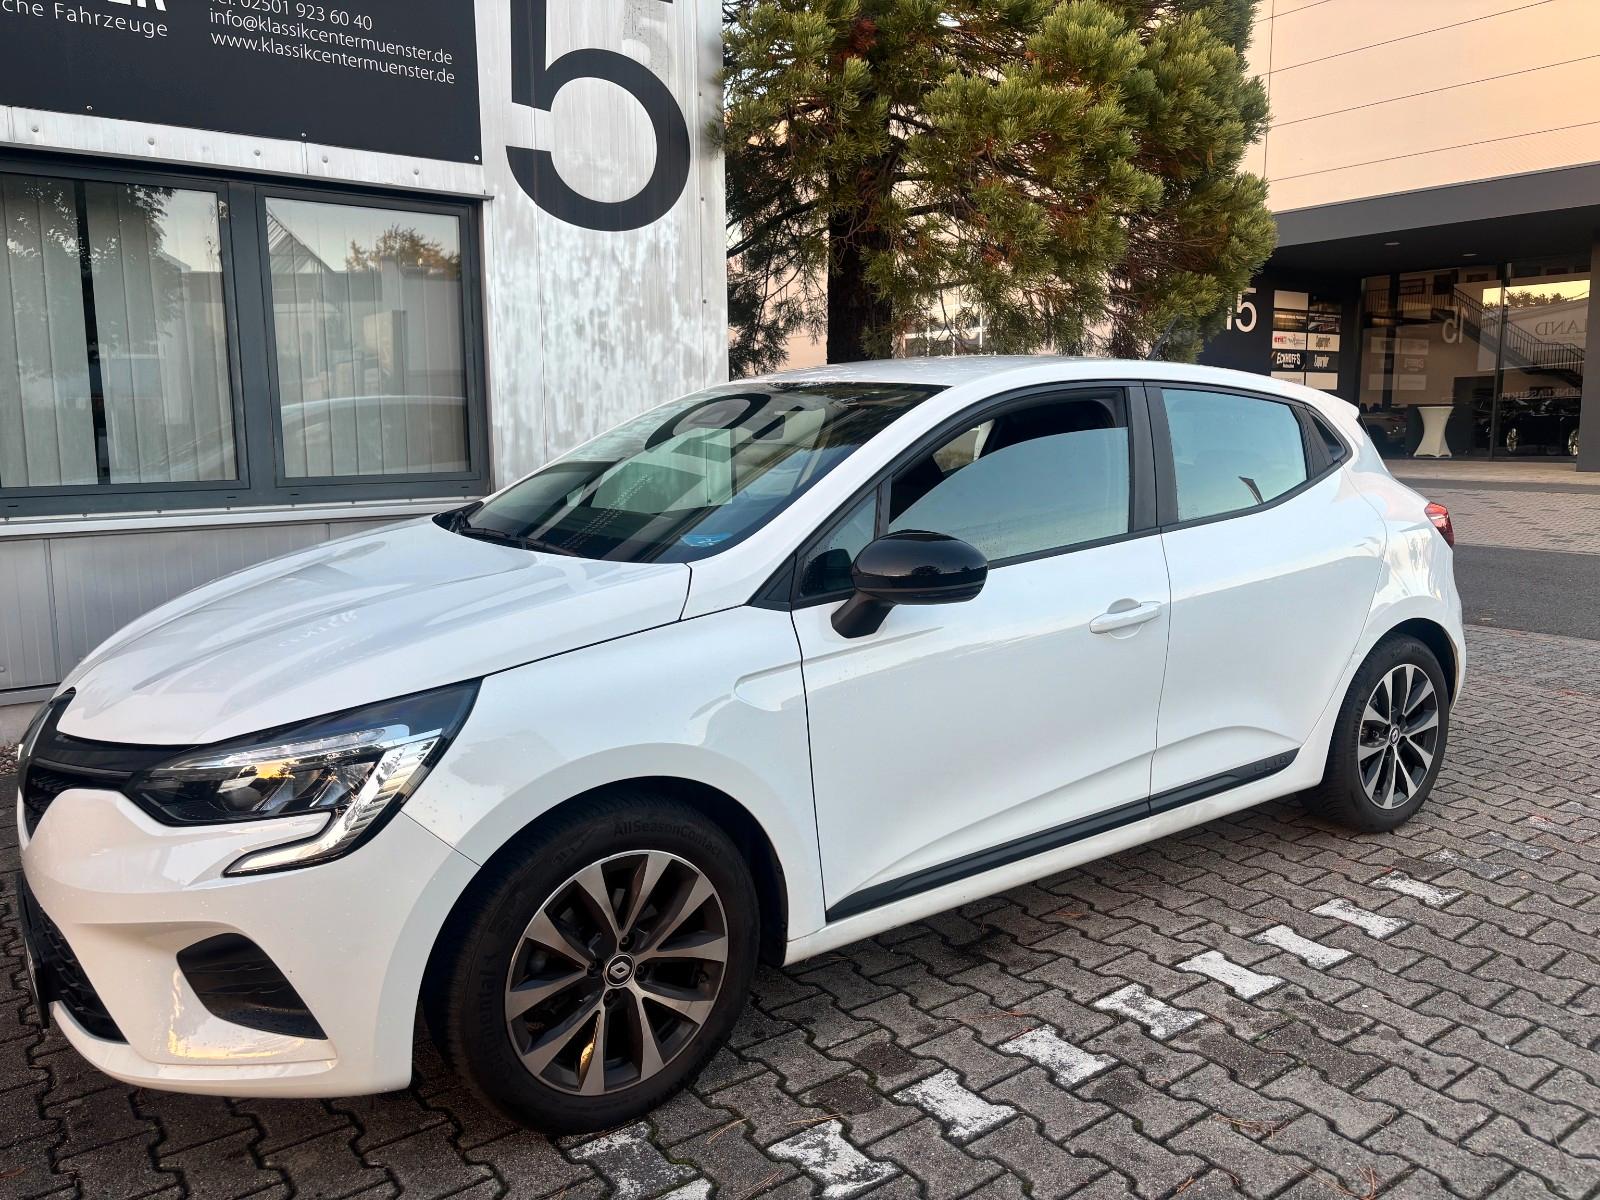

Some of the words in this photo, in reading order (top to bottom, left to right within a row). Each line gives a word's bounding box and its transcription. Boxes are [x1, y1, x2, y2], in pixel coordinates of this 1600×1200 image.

[54, 2, 168, 39] Fahrzeuge
[209, 7, 453, 65] info@klassikcentermuenster.de
[296, 3, 325, 22] 923
[330, 9, 349, 26] 60
[353, 14, 373, 31] 40
[210, 32, 455, 84] www.klassikcentermuenster.de
